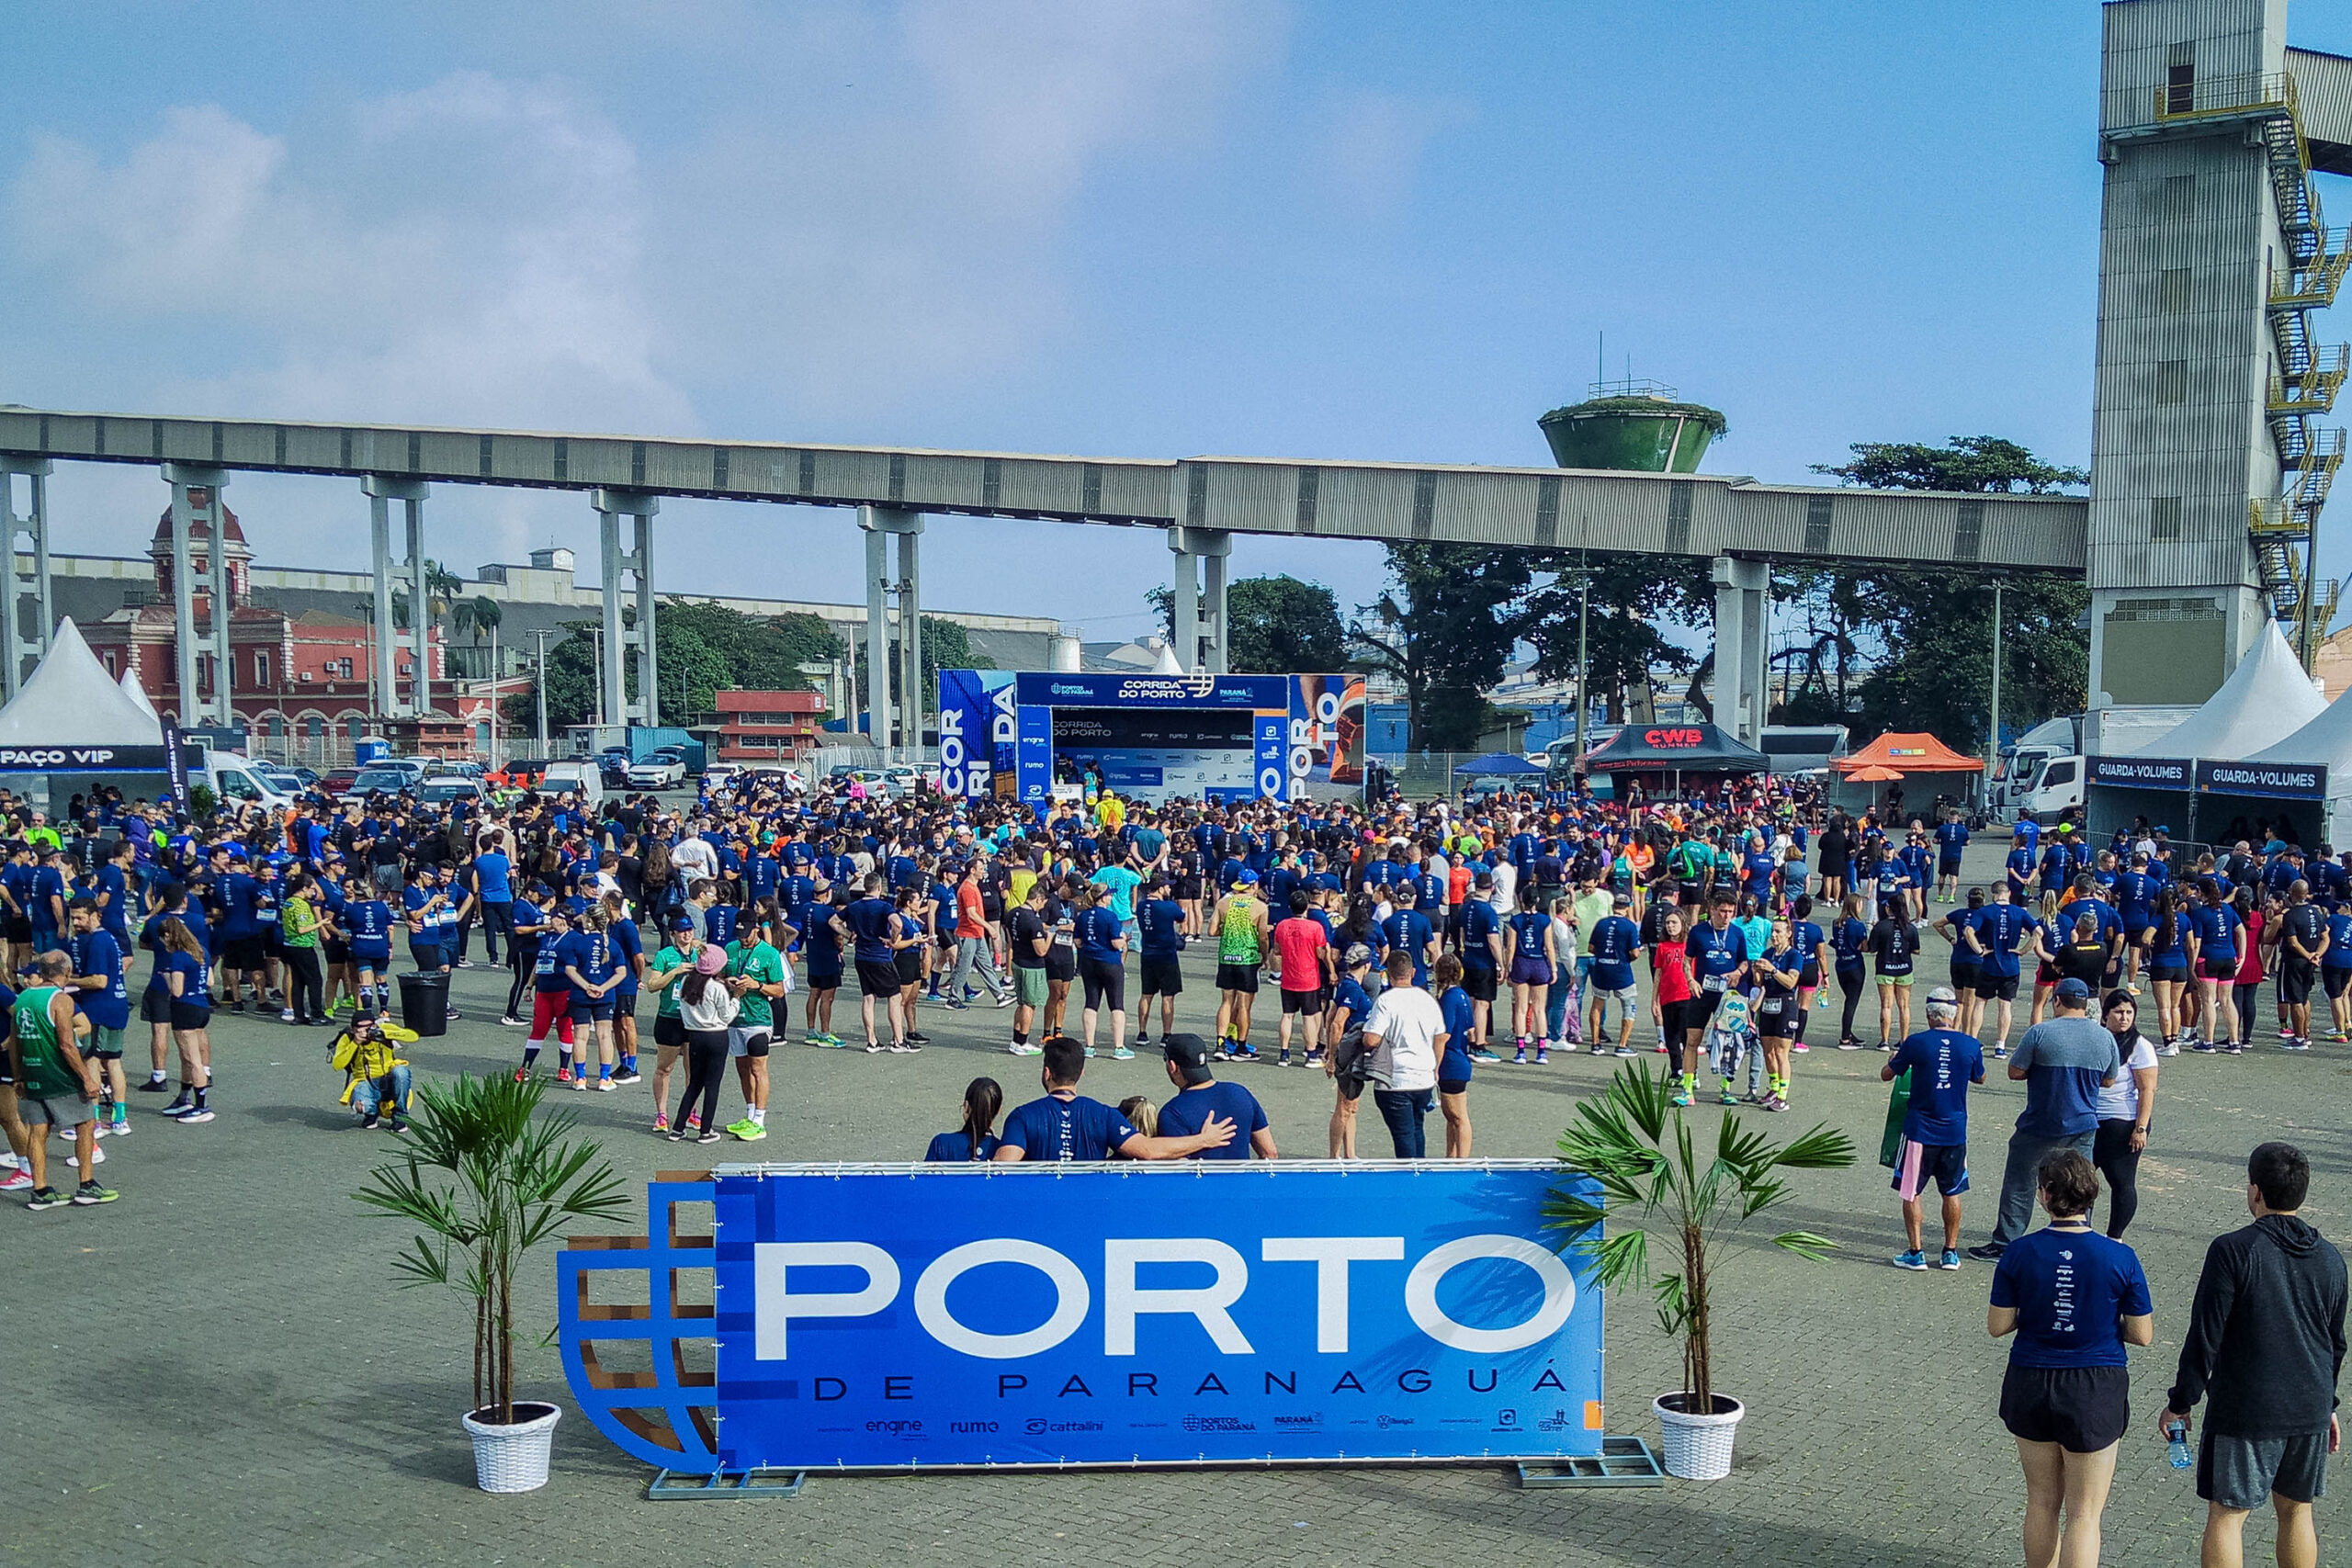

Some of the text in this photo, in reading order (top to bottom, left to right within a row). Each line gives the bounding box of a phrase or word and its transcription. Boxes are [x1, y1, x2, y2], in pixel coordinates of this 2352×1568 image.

[1124, 681, 1182, 689] CORRIDA
[1118, 690, 1186, 699] DO PORTO
[992, 683, 1015, 742] DA
[1317, 692, 1339, 750] TO
[1071, 728, 1112, 737] PORTO
[1645, 728, 1702, 744] CWB
[72, 750, 114, 763] VIP
[941, 709, 964, 797] COR
[2098, 762, 2183, 779] GUARDA-VOLUMES
[2212, 769, 2315, 787] GUARDA-VOLUMES
[754, 1235, 1576, 1360] PORTO
[814, 1359, 1566, 1401] DE PARANAGUÁ
[865, 1419, 922, 1437] engine
[950, 1421, 999, 1433] rumo
[1050, 1421, 1103, 1432] cattalini
[1274, 1416, 1313, 1425] PARANÁ
